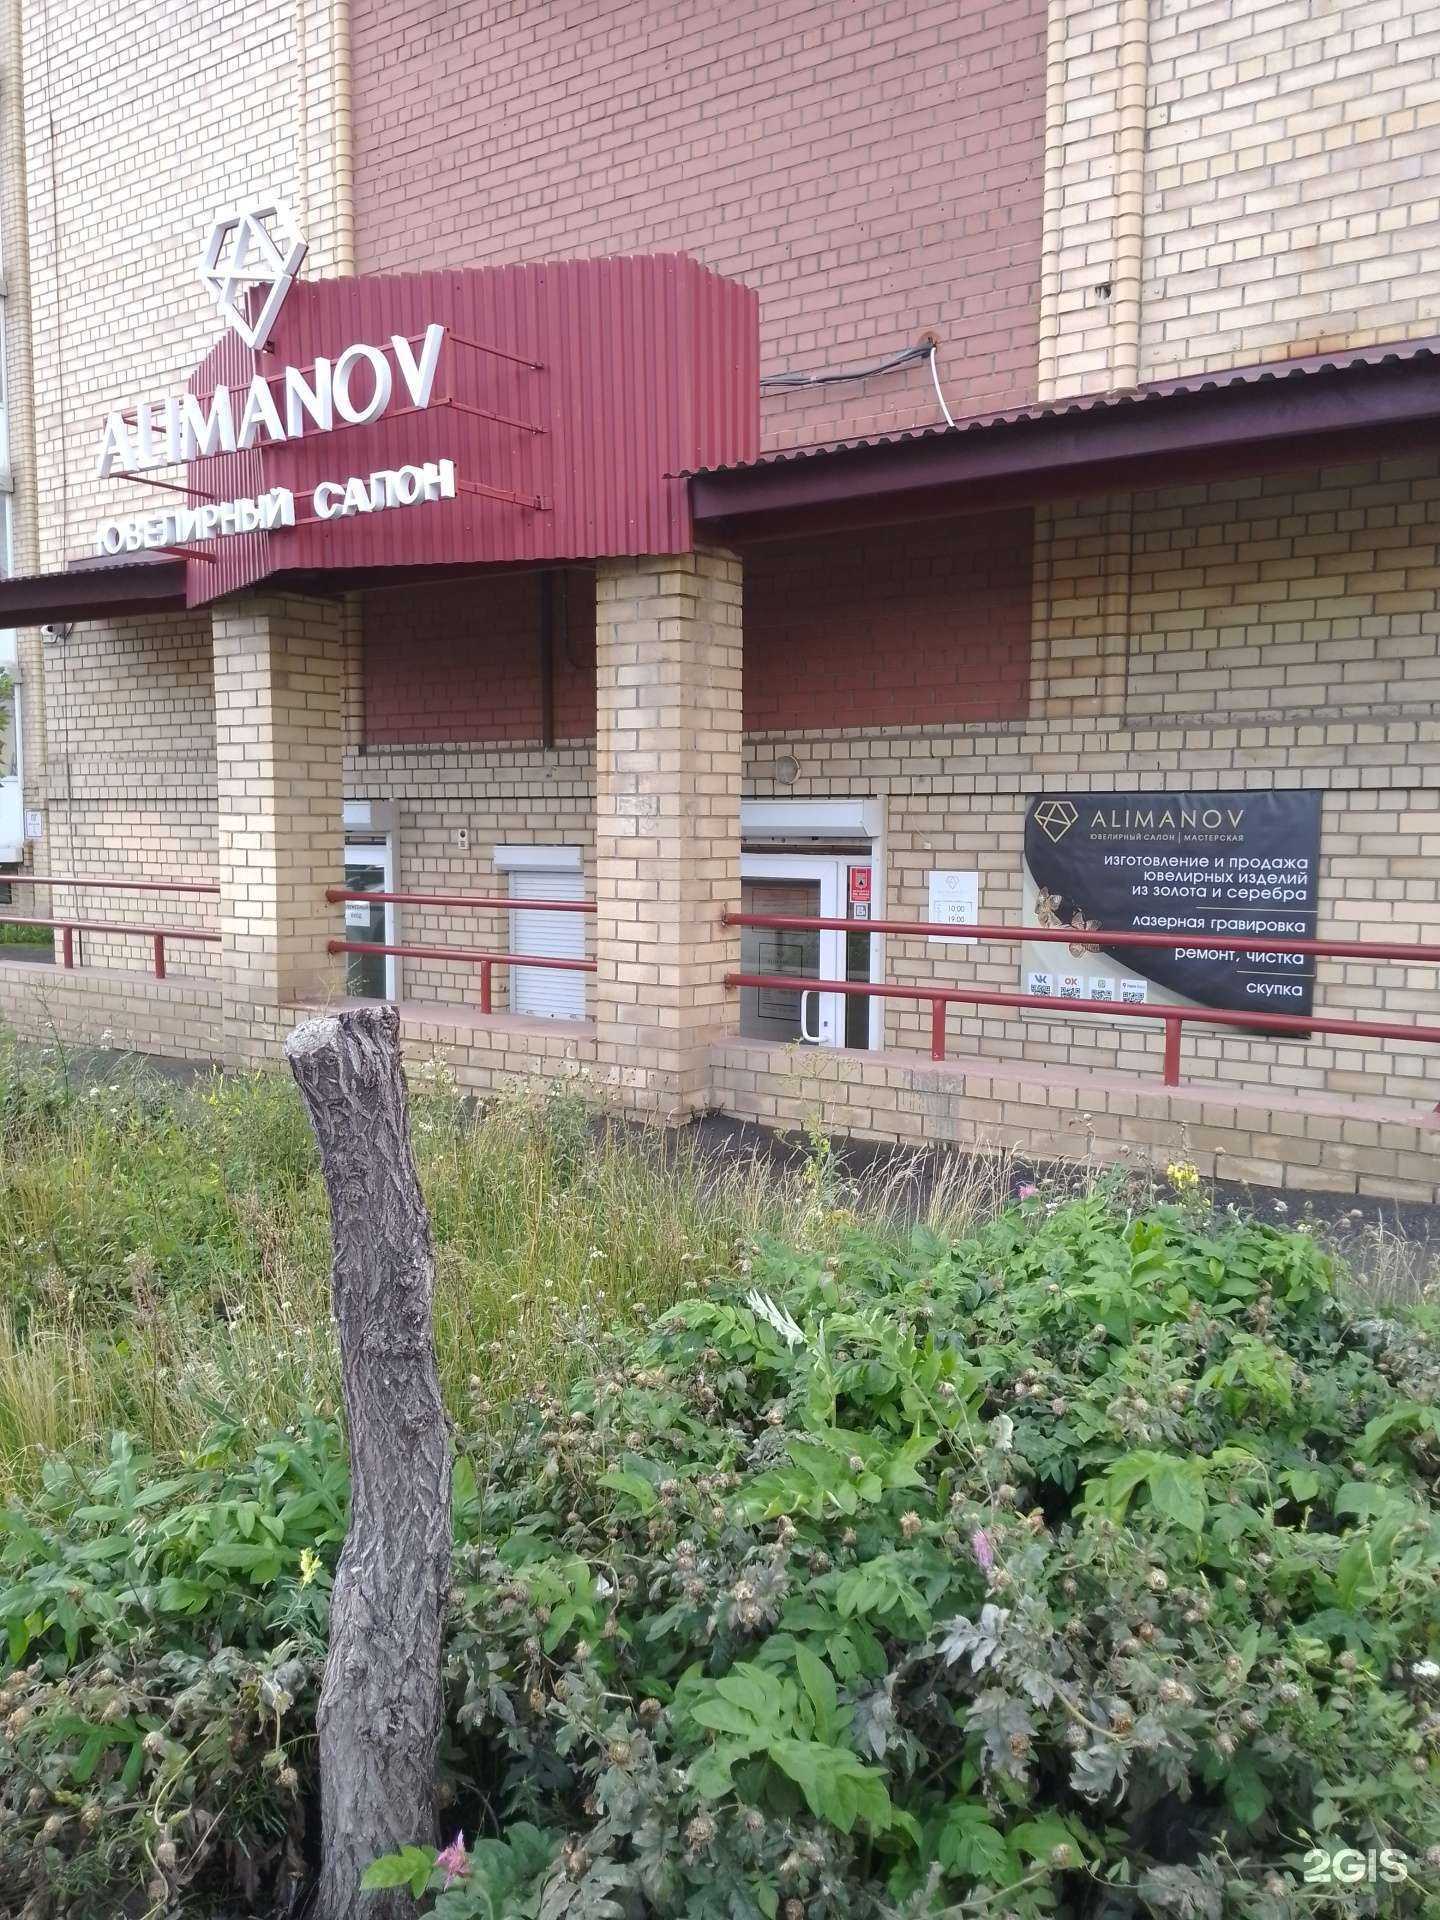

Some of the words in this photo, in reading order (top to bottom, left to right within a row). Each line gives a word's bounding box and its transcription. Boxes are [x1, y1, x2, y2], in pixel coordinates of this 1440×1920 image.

[98, 323, 445, 478] ALIMANOV
[313, 458, 456, 519] САЛОН
[1090, 809, 1245, 829] ALIMANOV
[1090, 832, 1142, 842] ЮВЕЛИРНЫЙ
[1143, 833, 1175, 842] САЛОН
[1183, 833, 1245, 843] МАСТЕРСКАЯ
[1104, 855, 1210, 868] изготовление
[1214, 857, 1224, 868] и
[1229, 857, 1309, 870] продажа
[1144, 871, 1234, 885] ювелирных
[1238, 871, 1308, 885] изделий
[1132, 885, 1148, 896] из
[1153, 886, 1207, 898] золота
[1212, 887, 1222, 898] и
[1227, 886, 1307, 902] серебра
[1132, 915, 1205, 930] лазерная
[1210, 918, 1306, 933] гравировка
[1175, 947, 1240, 962] ремонт,
[1246, 951, 1304, 965] чистка
[1246, 982, 1303, 997] скупка
